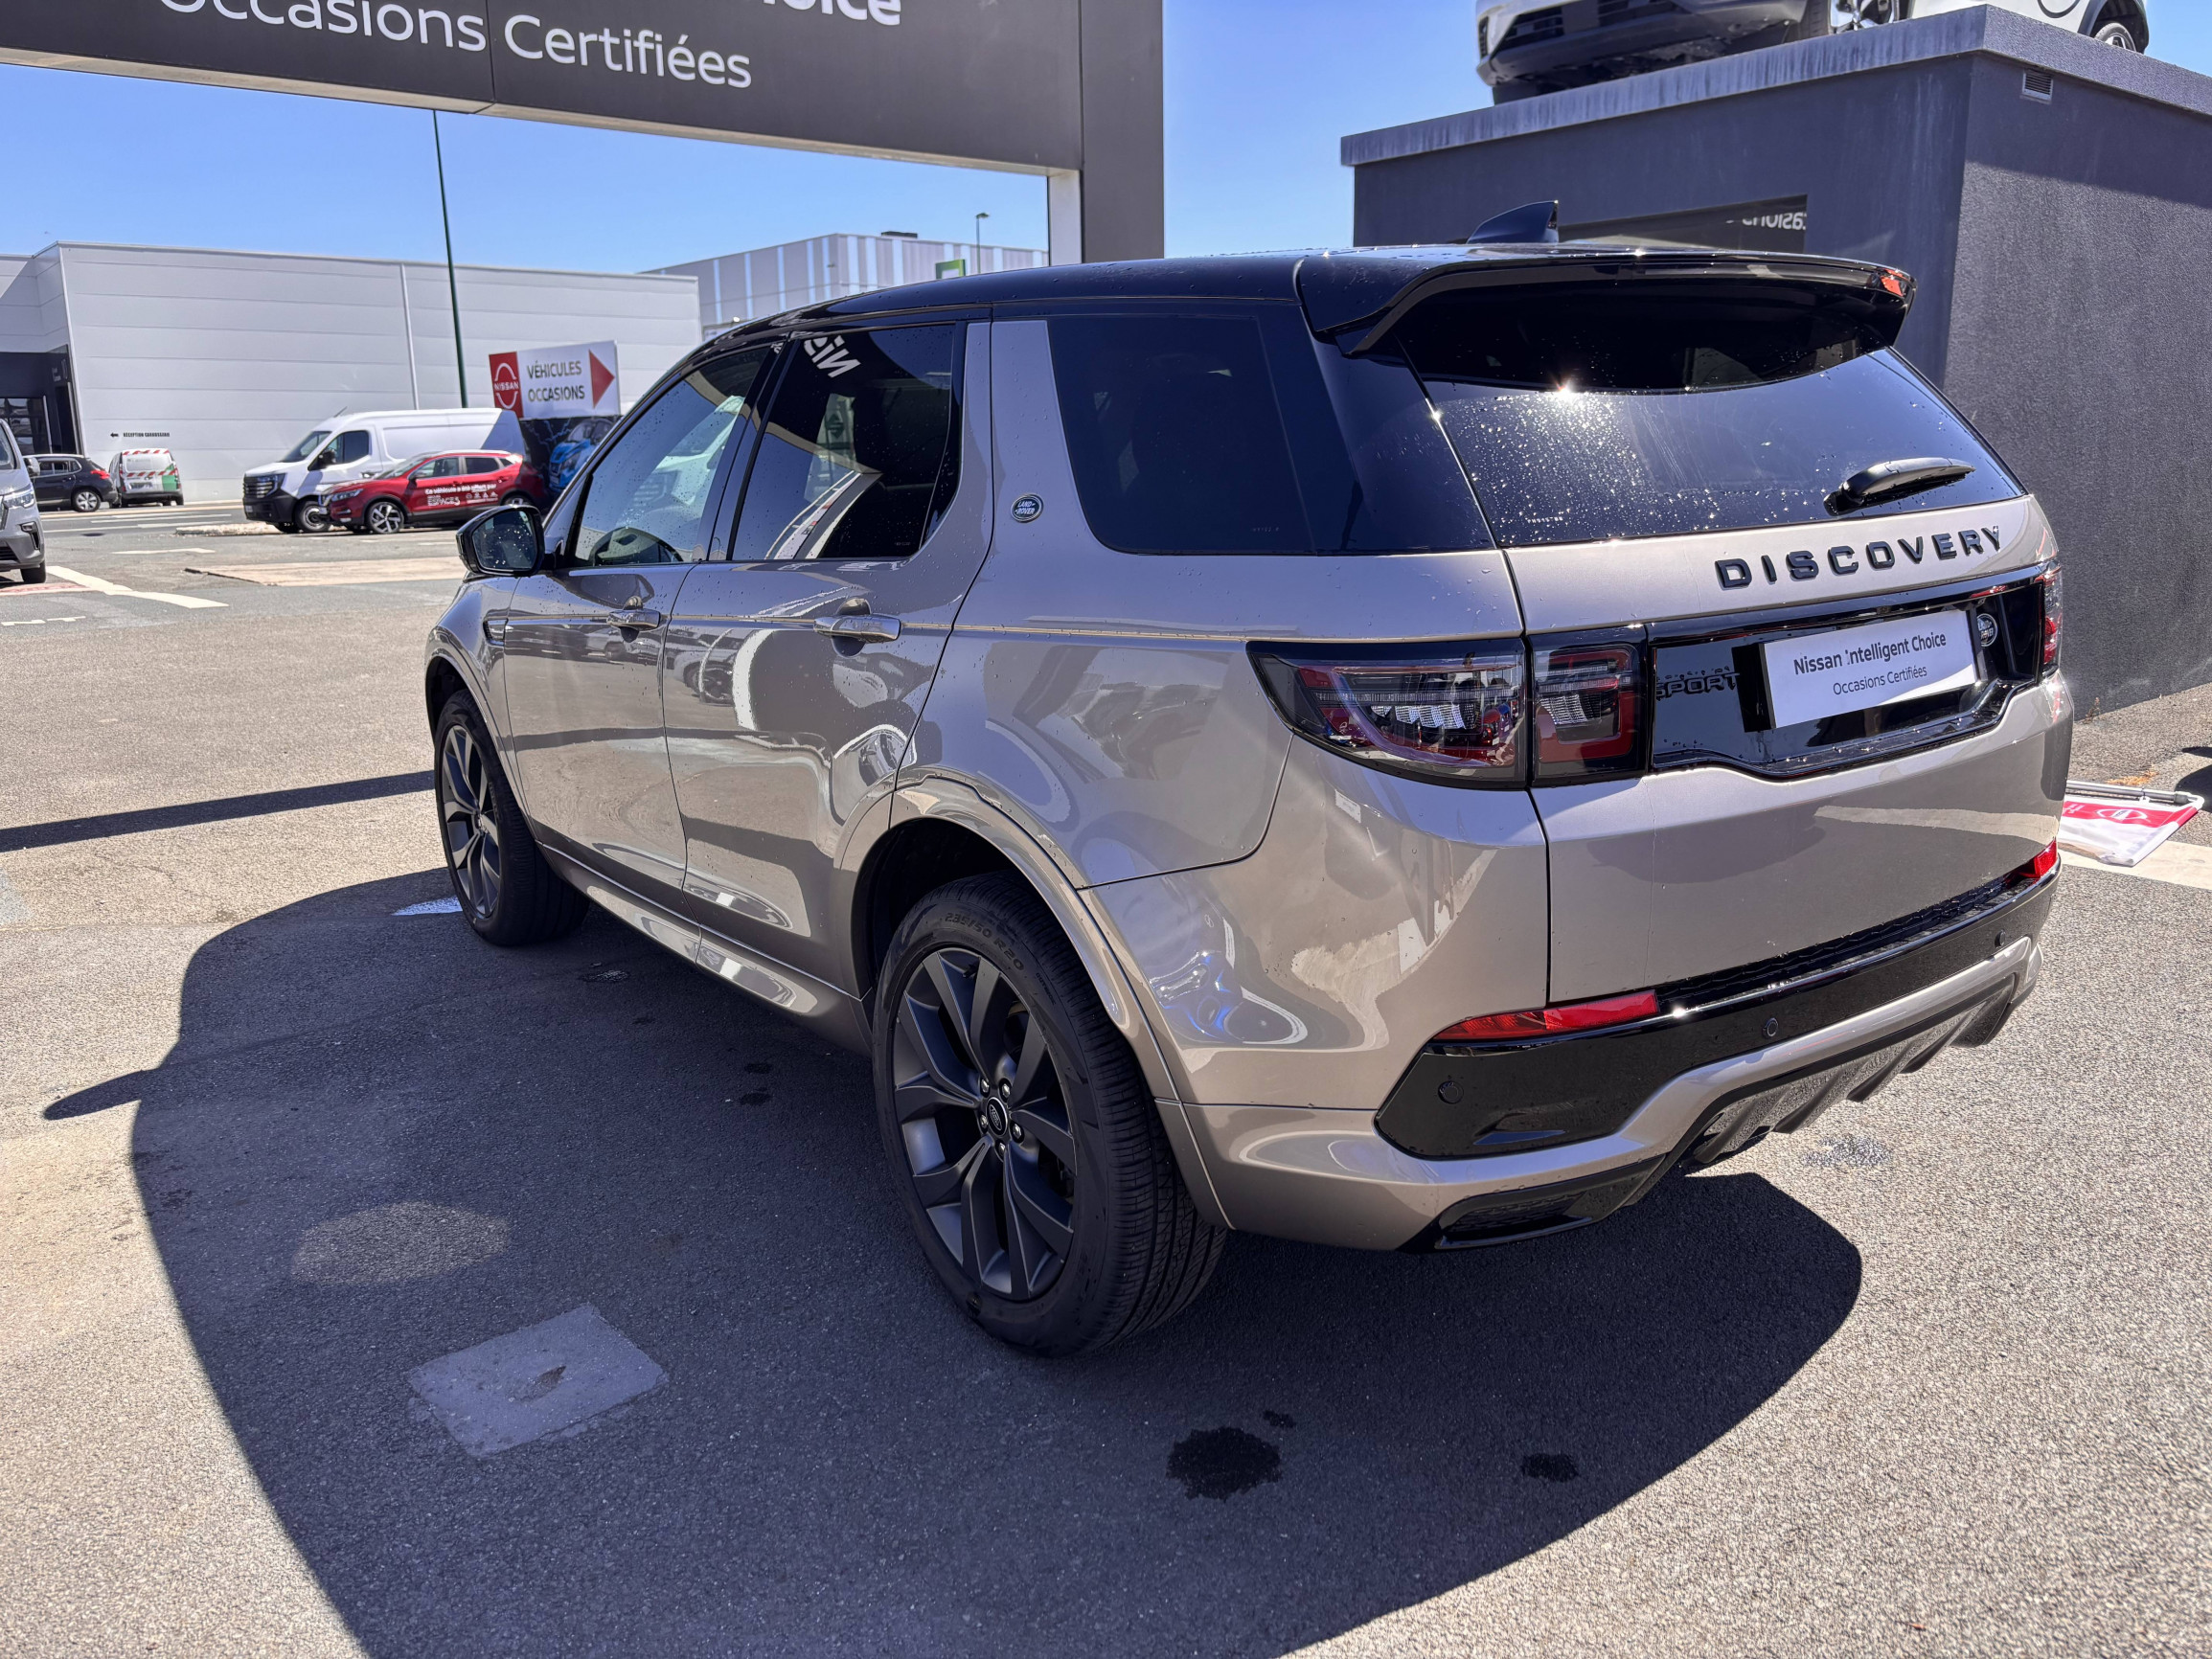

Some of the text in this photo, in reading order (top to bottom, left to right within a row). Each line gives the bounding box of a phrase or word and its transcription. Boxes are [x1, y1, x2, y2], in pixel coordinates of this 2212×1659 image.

[160, 0, 752, 88] ccasions Certifiées
[527, 359, 582, 379] VÉHICULES
[494, 381, 519, 392] NISSAN
[528, 385, 585, 402] OCCASIONS
[1715, 525, 2001, 590] DISCOVERY
[1793, 653, 1842, 675] Nissan
[1911, 632, 1947, 651] Choice
[1833, 665, 1927, 695] Occasions Certifiées
